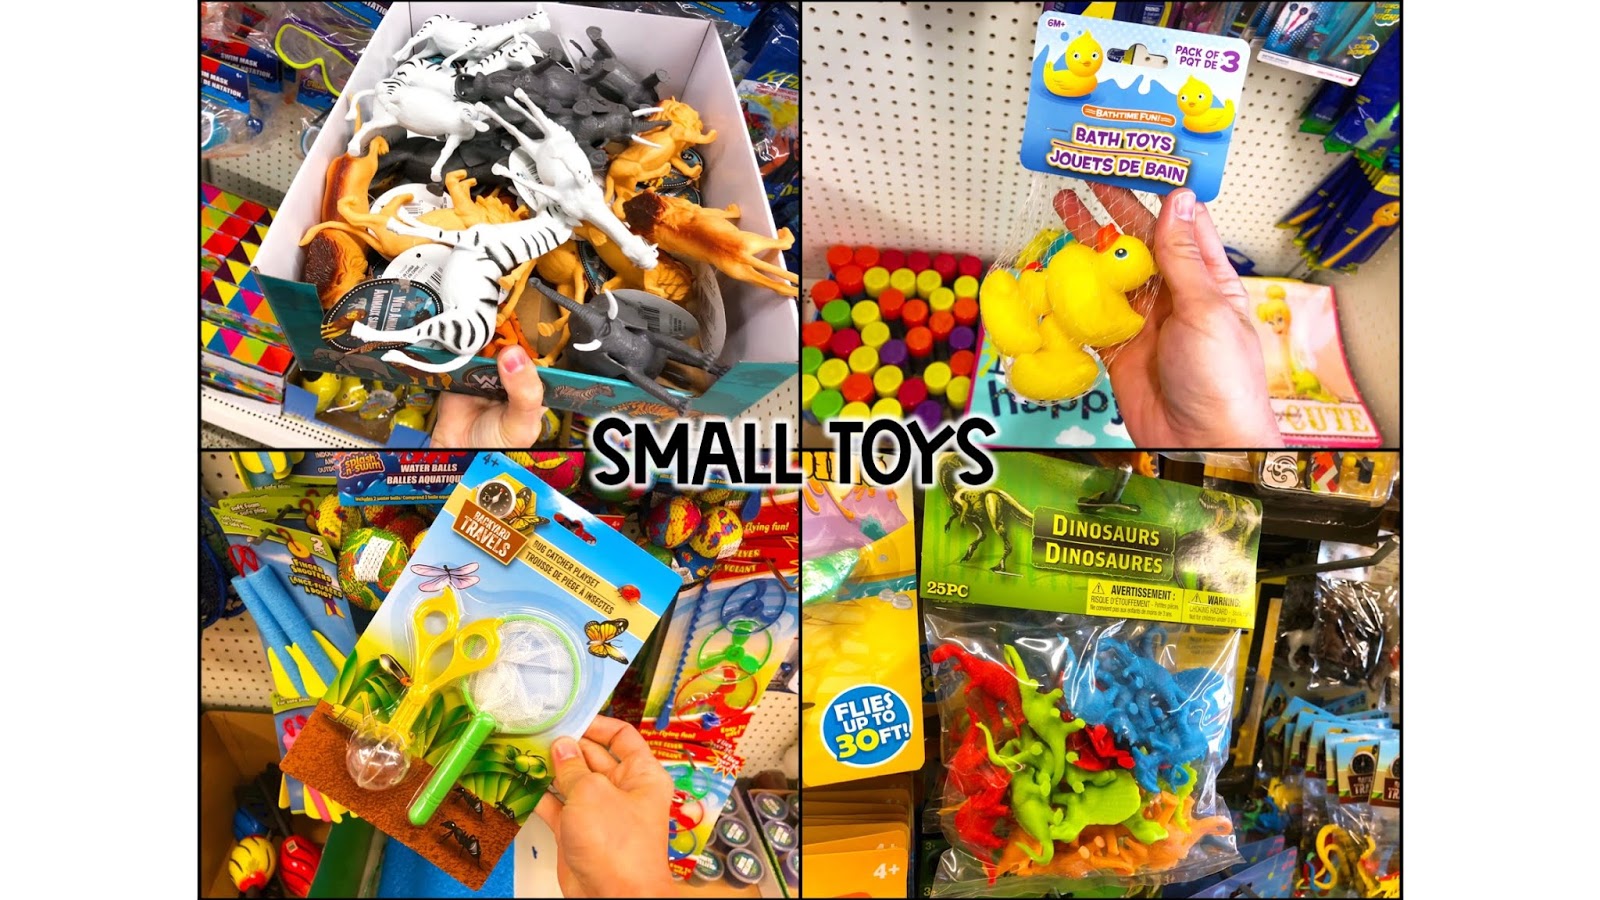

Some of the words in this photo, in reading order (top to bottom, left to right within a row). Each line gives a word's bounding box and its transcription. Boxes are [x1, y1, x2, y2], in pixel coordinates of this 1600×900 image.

[363, 1, 389, 16] TATIO
[1047, 18, 1066, 28] 6M+
[1175, 45, 1203, 58] PACK
[1205, 50, 1220, 60] OF
[239, 57, 258, 68] MASK
[1179, 56, 1202, 68] PQT
[1204, 60, 1218, 70] DE
[1220, 50, 1240, 73] 3
[203, 79, 211, 87] DE
[211, 80, 242, 98] NATATION
[210, 74, 229, 86] MASK
[1095, 109, 1139, 120] BATHTIME
[1139, 111, 1161, 123] FUN!
[1075, 127, 1121, 147] BATH
[1126, 132, 1173, 152] TOYS
[1050, 150, 1114, 173] JOUETS
[1118, 159, 1141, 174] DE
[1144, 162, 1186, 182] BAIN
[368, 288, 389, 317] ANIMAUX
[1286, 404, 1370, 432] CUTE
[345, 454, 376, 470] splash
[400, 463, 431, 473] WATER
[431, 463, 458, 472] BALLS
[482, 452, 499, 467] 4+
[386, 475, 418, 485] BALLES
[418, 474, 464, 485] AQUATIQU
[472, 511, 511, 541] BACKYARD
[1052, 514, 1160, 547] DINOSAURS
[460, 515, 511, 557] TRAVELS
[292, 558, 324, 573] FINGER
[532, 539, 547, 554] BUG
[546, 549, 574, 572] CATCHER
[572, 567, 600, 588] PLAYSET
[1045, 541, 1163, 574] DINOSAURES
[290, 564, 332, 582] SHOOTERS
[724, 563, 757, 573] VOLANT
[525, 551, 554, 575] TROUSSE
[552, 569, 563, 581] DE
[583, 591, 615, 615] INSECTES
[926, 581, 969, 598] 25PC
[1111, 584, 1172, 600] AVERTISSEMENT
[834, 692, 894, 722] FLIES
[843, 716, 869, 733] UP
[872, 709, 896, 726] TO
[873, 863, 900, 879] 4+
